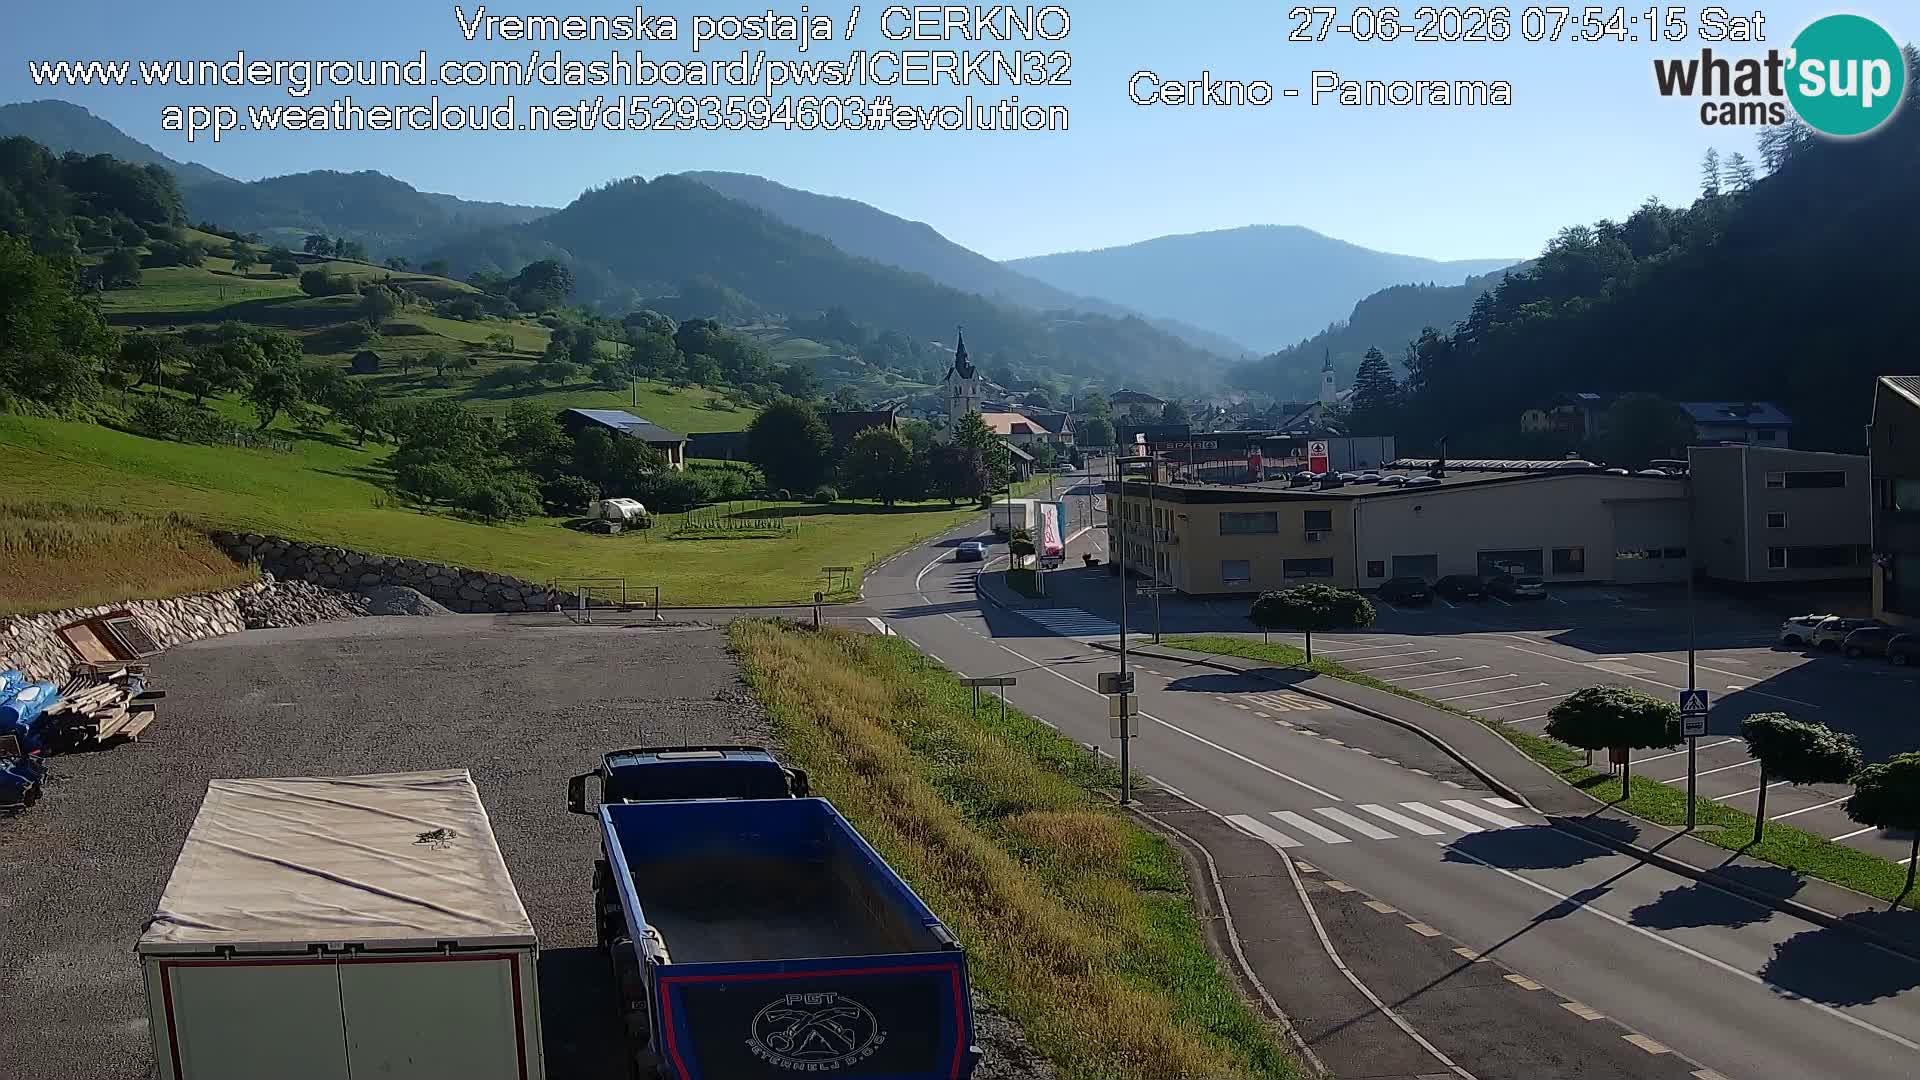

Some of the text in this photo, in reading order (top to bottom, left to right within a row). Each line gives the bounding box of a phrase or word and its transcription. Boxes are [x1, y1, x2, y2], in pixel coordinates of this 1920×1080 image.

[1240, 694, 1333, 712] BUS
[784, 991, 838, 1006] PGT
[744, 1038, 840, 1072] PETERNELJ
